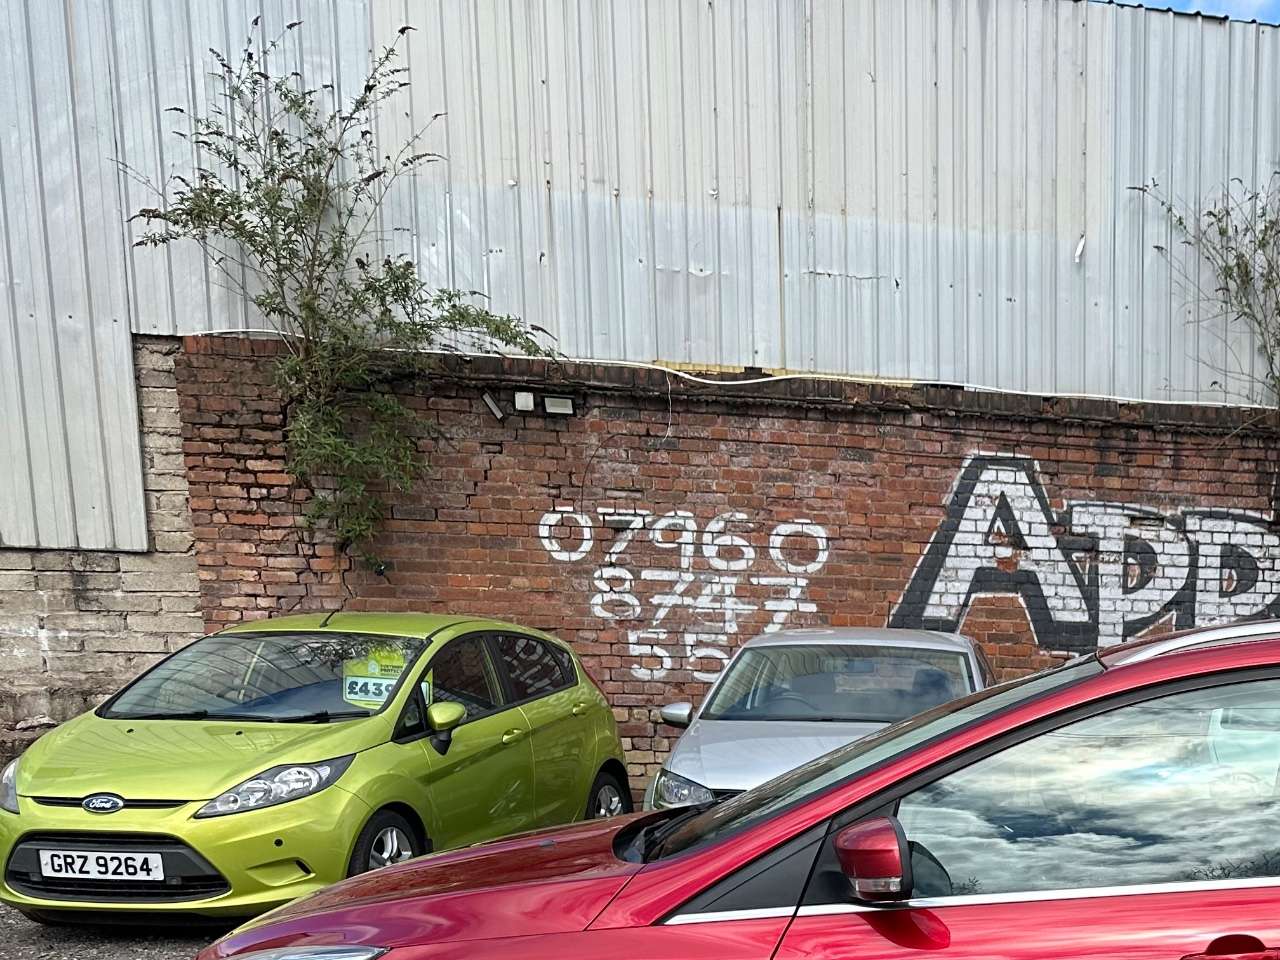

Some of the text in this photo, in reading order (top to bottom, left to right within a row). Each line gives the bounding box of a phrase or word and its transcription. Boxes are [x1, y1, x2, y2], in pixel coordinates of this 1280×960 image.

[538, 505, 830, 574] 07960
[591, 567, 817, 634] 8747
[88, 799, 115, 809] Ford
[50, 853, 152, 876] GRZ 9264
